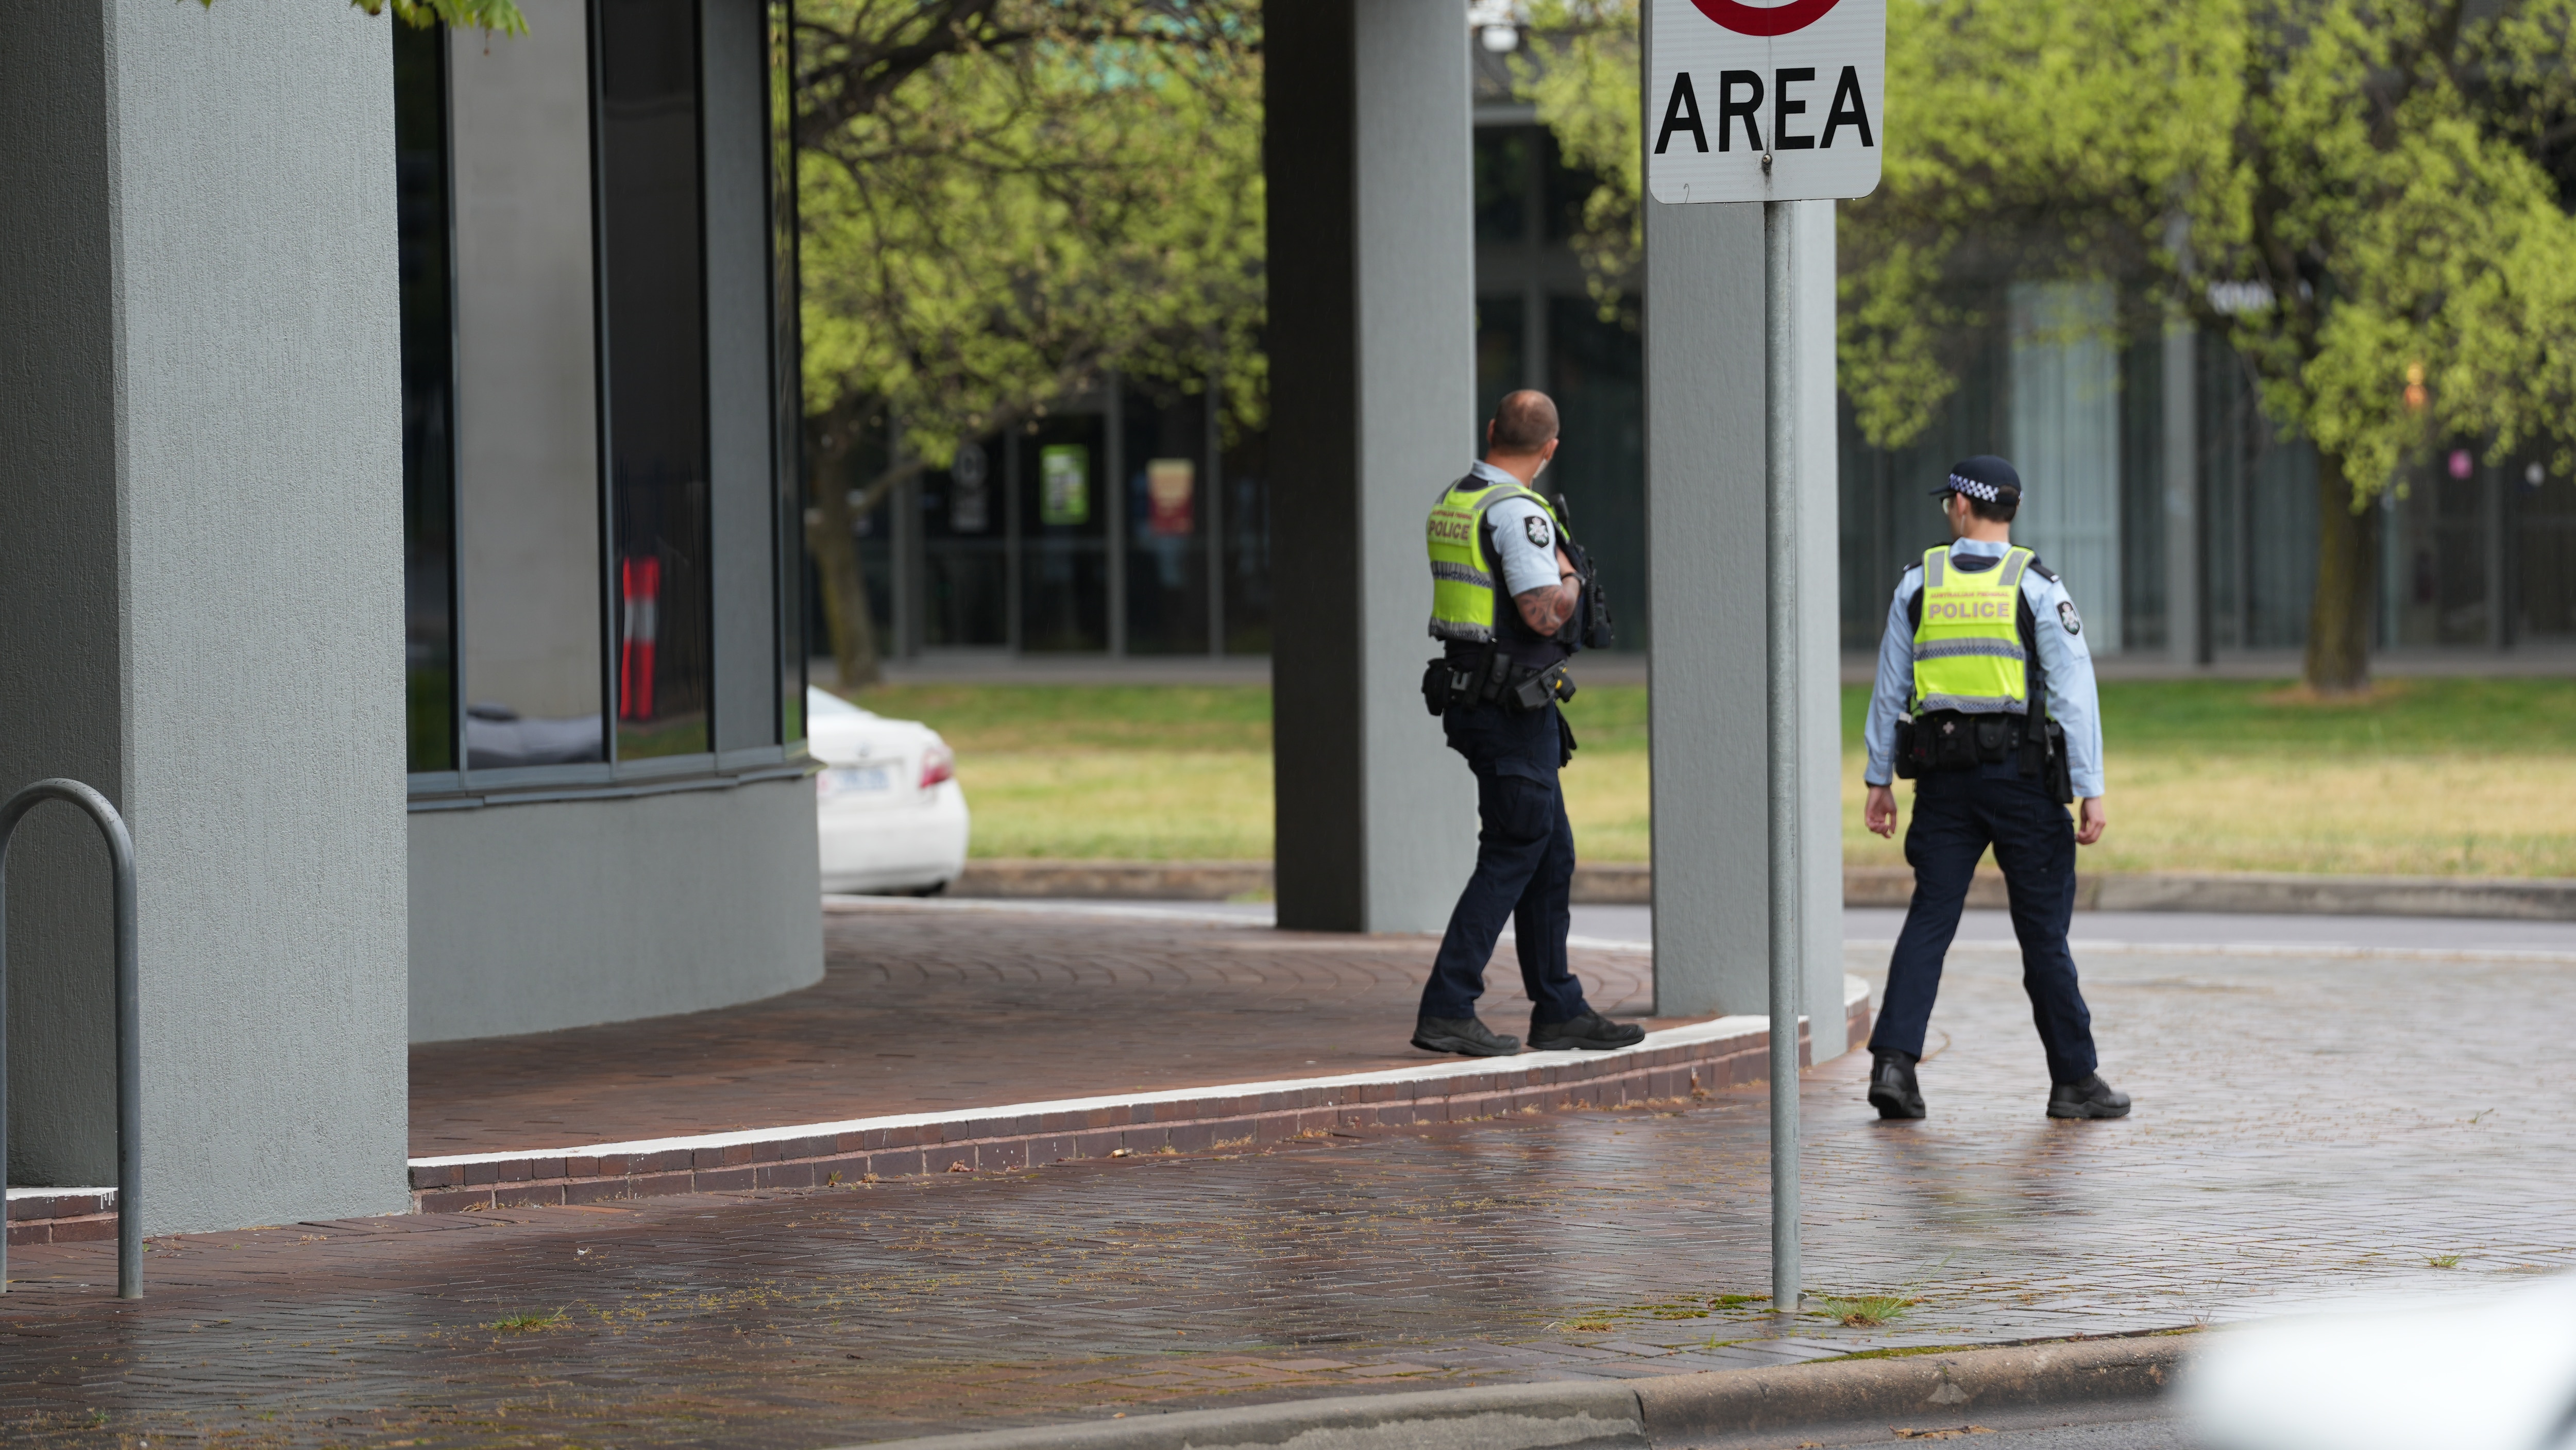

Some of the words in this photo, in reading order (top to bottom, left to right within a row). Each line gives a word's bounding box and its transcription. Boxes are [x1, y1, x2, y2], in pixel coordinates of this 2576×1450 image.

[1654, 65, 1874, 154] AREA
[1429, 520, 1470, 540] POLICE
[1928, 602, 2009, 619] POLICE
